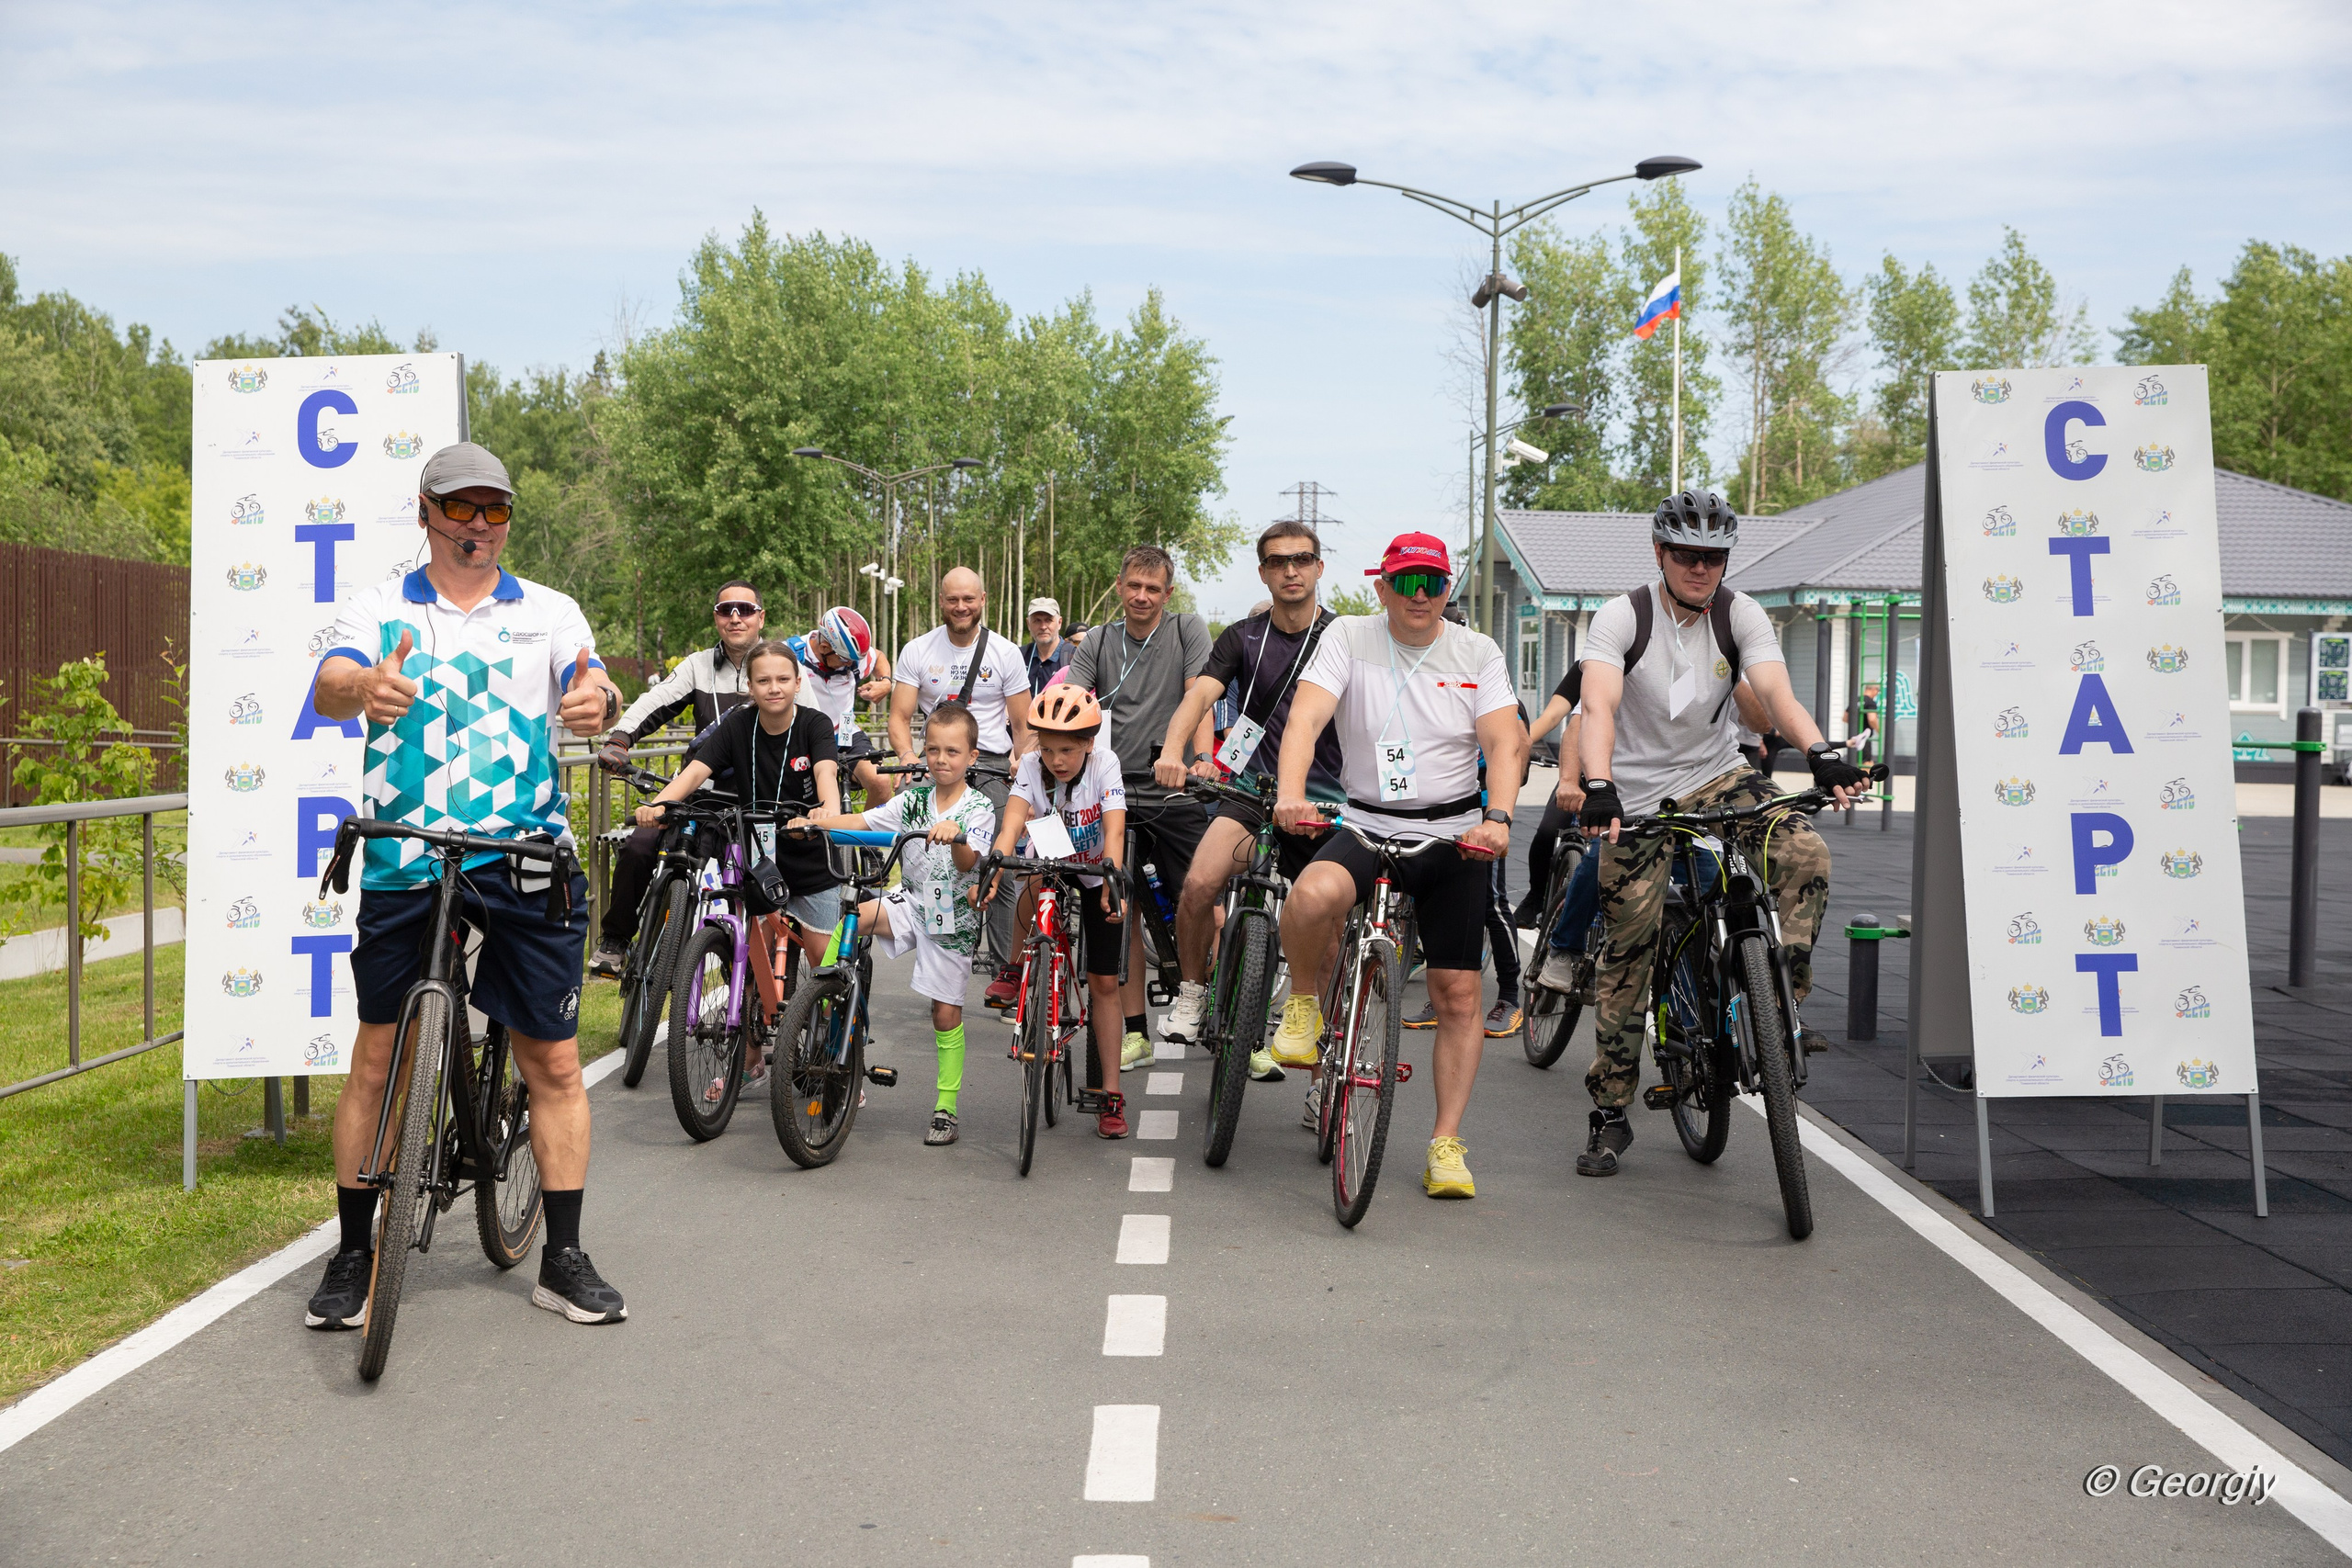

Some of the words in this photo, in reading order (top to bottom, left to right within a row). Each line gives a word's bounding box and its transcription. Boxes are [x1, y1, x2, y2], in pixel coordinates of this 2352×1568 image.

[843, 716, 851, 725] 78
[2044, 400, 2139, 1037] СТАРТ
[842, 732, 850, 741] 78
[1243, 727, 1253, 739] 5
[1230, 750, 1240, 761] 5
[1387, 748, 1405, 762] 54
[1390, 777, 1408, 791] 54
[934, 887, 942, 900] 9
[935, 914, 944, 926] 9
